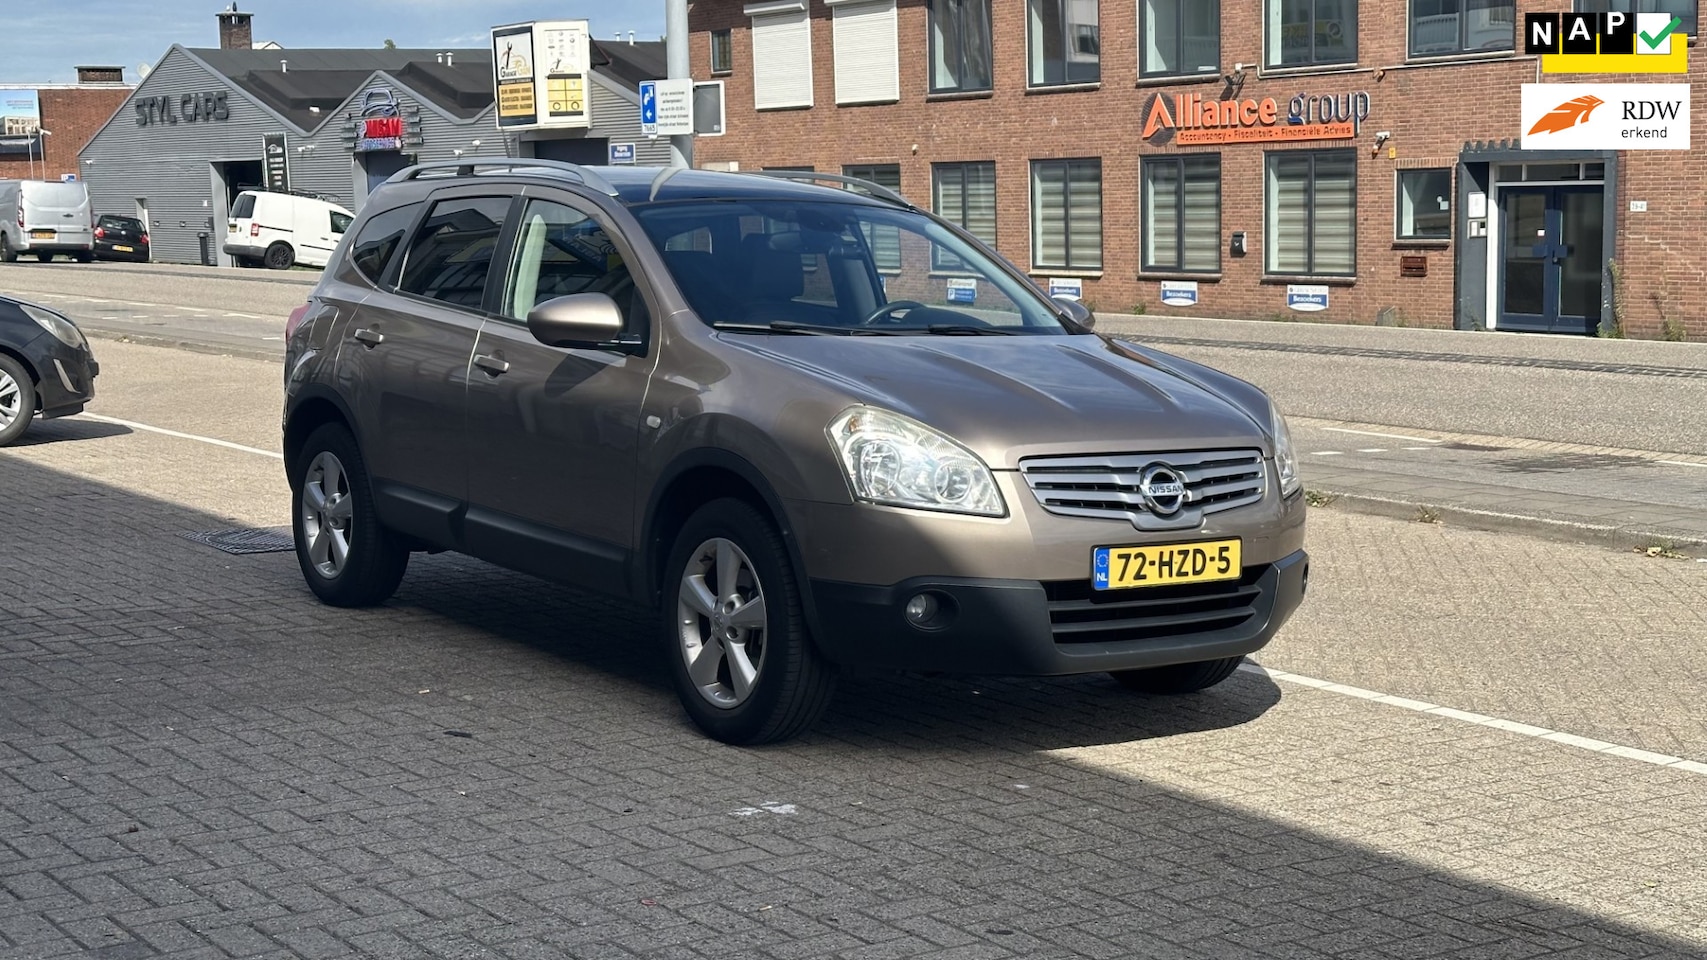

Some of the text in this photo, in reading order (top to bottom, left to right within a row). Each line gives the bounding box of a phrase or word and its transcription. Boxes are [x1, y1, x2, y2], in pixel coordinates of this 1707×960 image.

[135, 90, 229, 126] STYL CARS
[1142, 90, 1371, 140] Alliance group
[1179, 125, 1352, 142] Accountancy Fiscaliteit Financiële Advies
[1166, 290, 1192, 299] Bezoekers
[1292, 294, 1322, 303] Bezoekers
[1148, 484, 1184, 495] NISSAN
[1117, 546, 1231, 582] 72-HZD-5
[1096, 573, 1108, 582] NL
